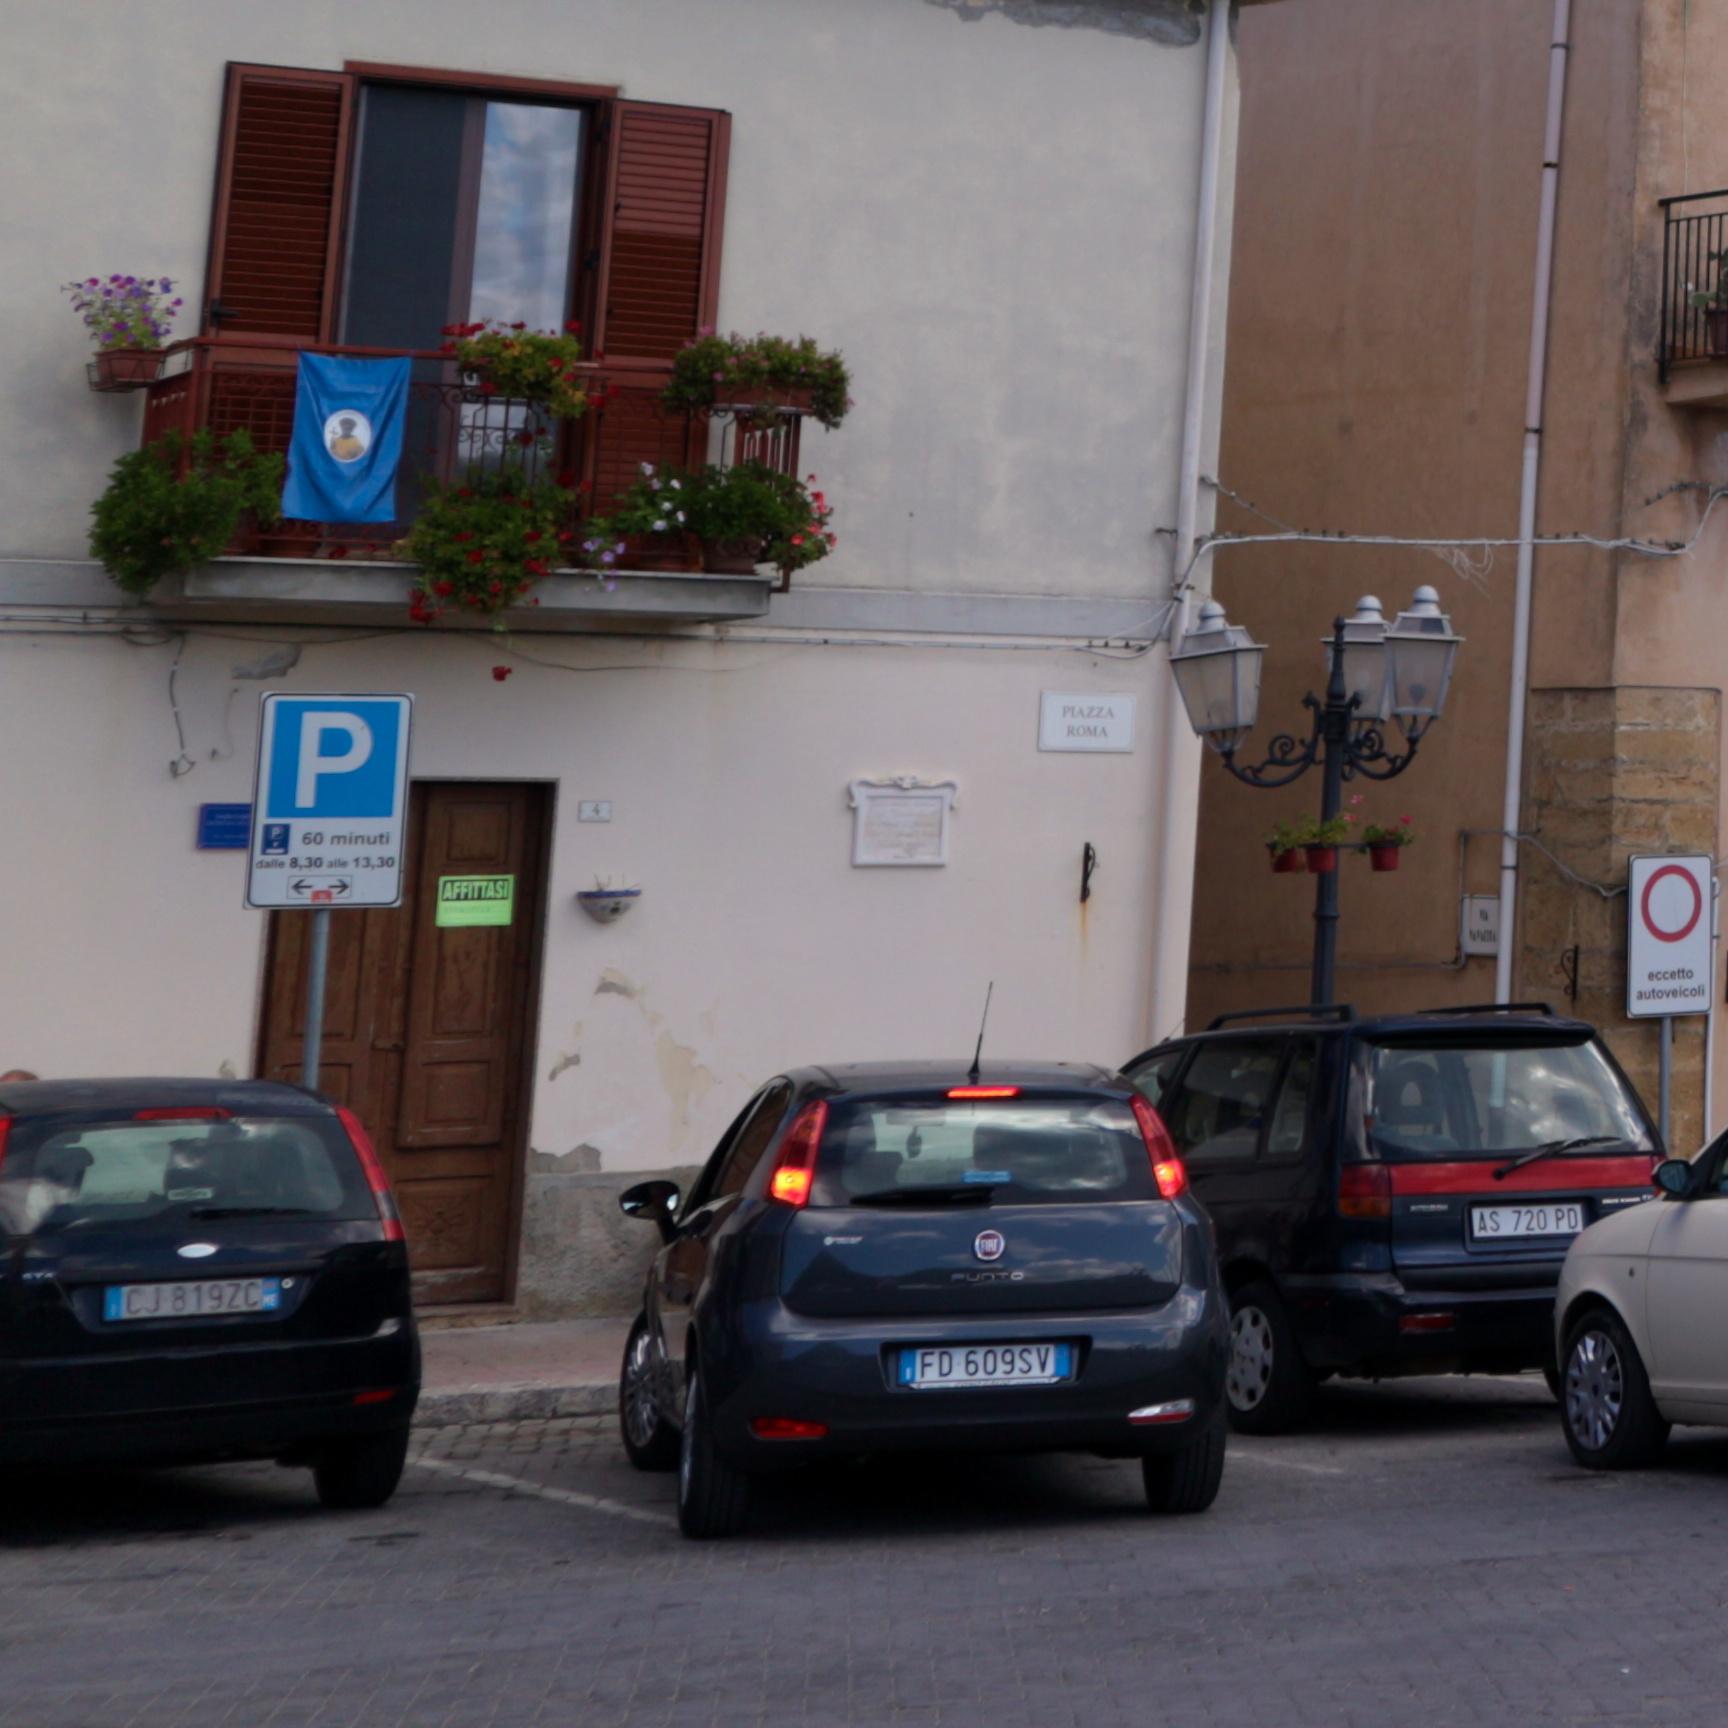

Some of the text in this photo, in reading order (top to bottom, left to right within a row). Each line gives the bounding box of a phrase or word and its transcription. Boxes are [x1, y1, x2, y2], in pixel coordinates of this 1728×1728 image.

[1062, 705, 1115, 720] PIAZZA
[1065, 725, 1109, 738] ROMA
[295, 711, 374, 808] P
[302, 832, 390, 846] 60 minuti
[256, 857, 285, 870] dalle
[326, 857, 348, 869] alle
[354, 856, 396, 870] 13,30
[442, 881, 508, 900] AFFITTASI
[1647, 968, 1694, 982] eccetto
[1636, 984, 1706, 1001] autoveicoli
[1478, 1208, 1578, 1233] AS 720 PD
[951, 1271, 1024, 1282] PUNTO
[126, 1286, 162, 1315] CJ
[171, 1282, 259, 1312] 819ZC
[920, 1350, 953, 1379] FD
[965, 1347, 1050, 1377] 609SV
